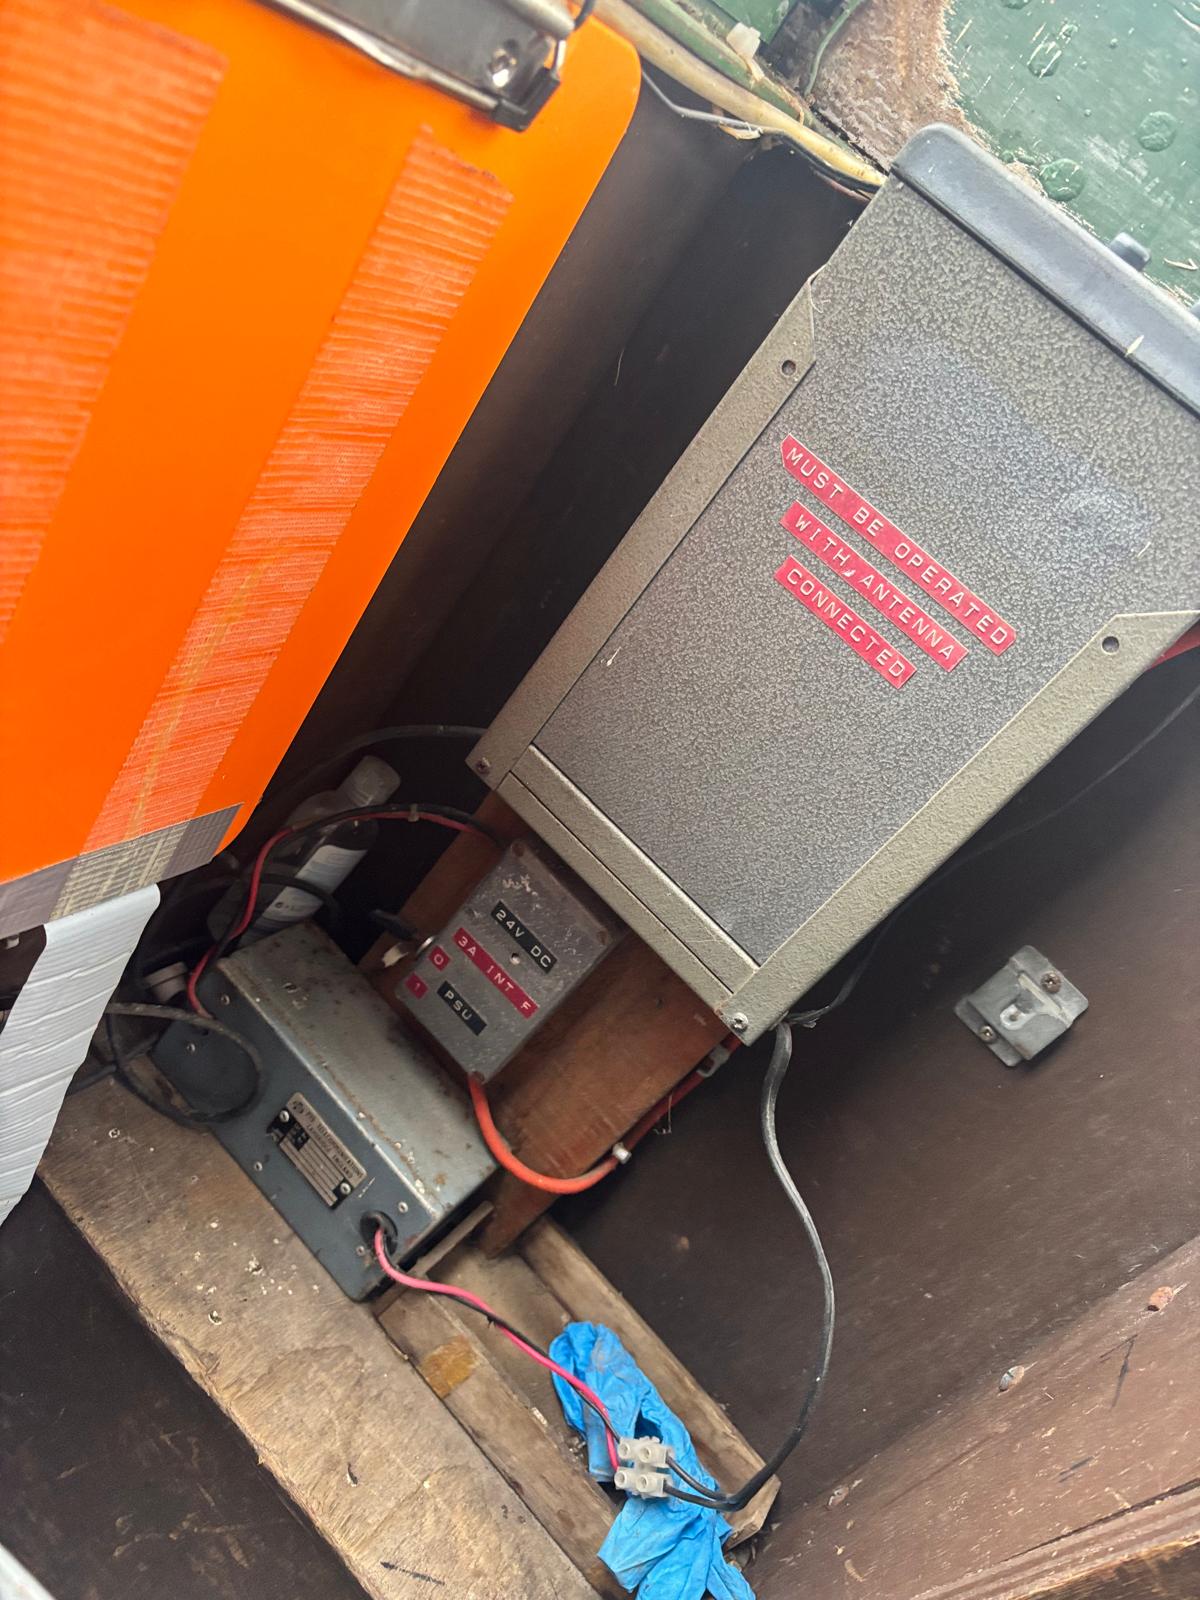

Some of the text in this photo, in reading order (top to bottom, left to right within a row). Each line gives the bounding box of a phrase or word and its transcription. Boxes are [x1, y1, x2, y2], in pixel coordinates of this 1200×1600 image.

[786, 447, 1008, 645] MUST BE OPERATED
[786, 568, 905, 677] CONNECTED
[859, 574, 955, 660] ANTENNA
[458, 935, 532, 1010] 3A INT F
[496, 909, 552, 968] 24V DC
[444, 990, 473, 1021] PSU
